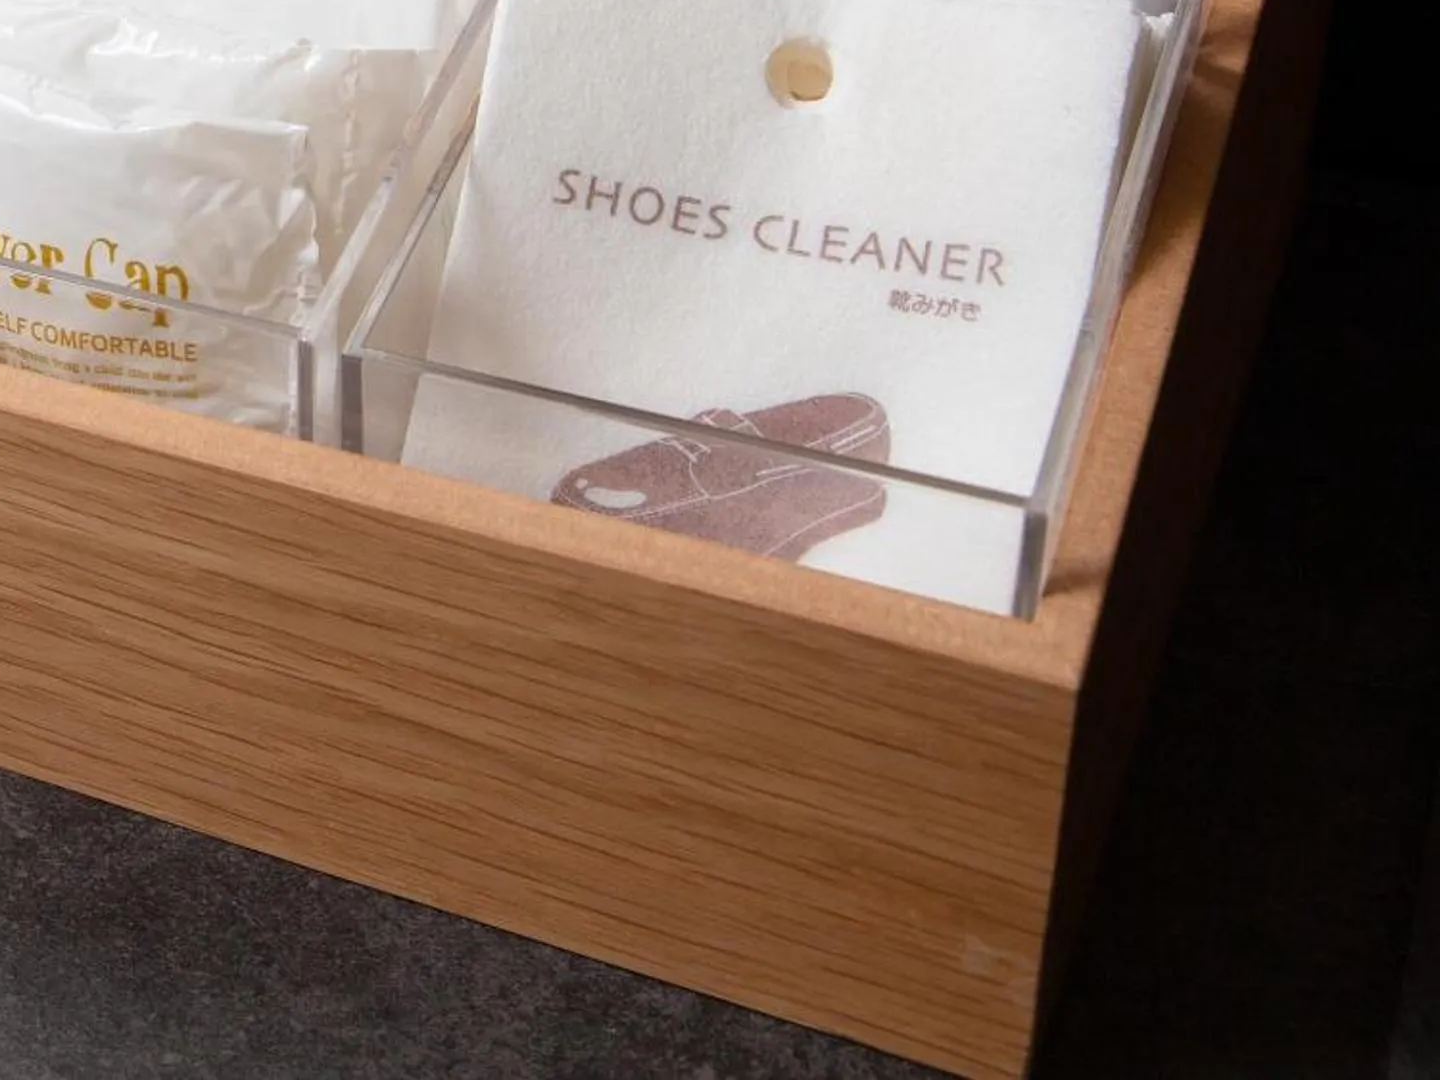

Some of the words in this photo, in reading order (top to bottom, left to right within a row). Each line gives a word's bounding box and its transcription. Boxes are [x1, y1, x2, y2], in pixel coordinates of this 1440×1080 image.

[553, 168, 731, 239] SHOES
[752, 214, 1006, 286] CLEANER
[84, 237, 190, 328] Cap
[30, 323, 198, 363] COMFORTABLE
